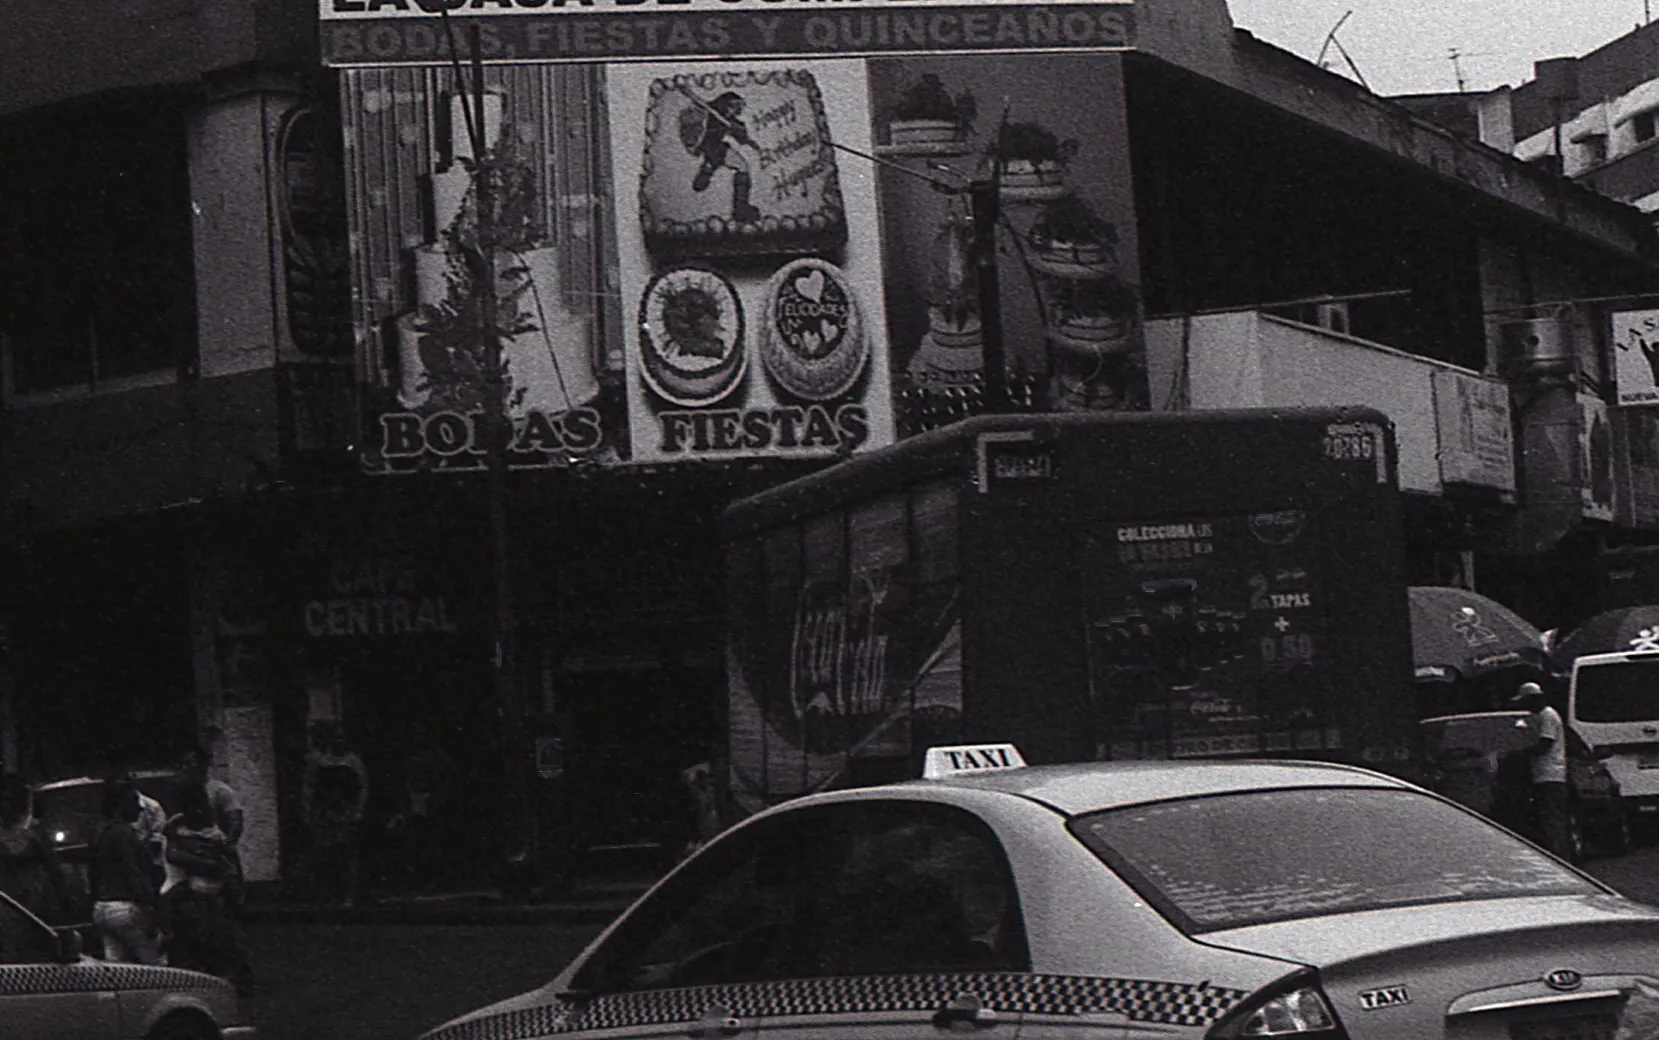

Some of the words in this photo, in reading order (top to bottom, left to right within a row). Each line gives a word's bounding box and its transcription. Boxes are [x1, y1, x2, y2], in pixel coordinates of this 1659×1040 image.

[528, 17, 730, 52] FIESTAS
[751, 15, 785, 48] Y
[658, 404, 869, 454] FIESTAS
[302, 595, 459, 637] CENTRAL
[942, 748, 1010, 769] TAXI
[1361, 987, 1409, 1007] TAXI
